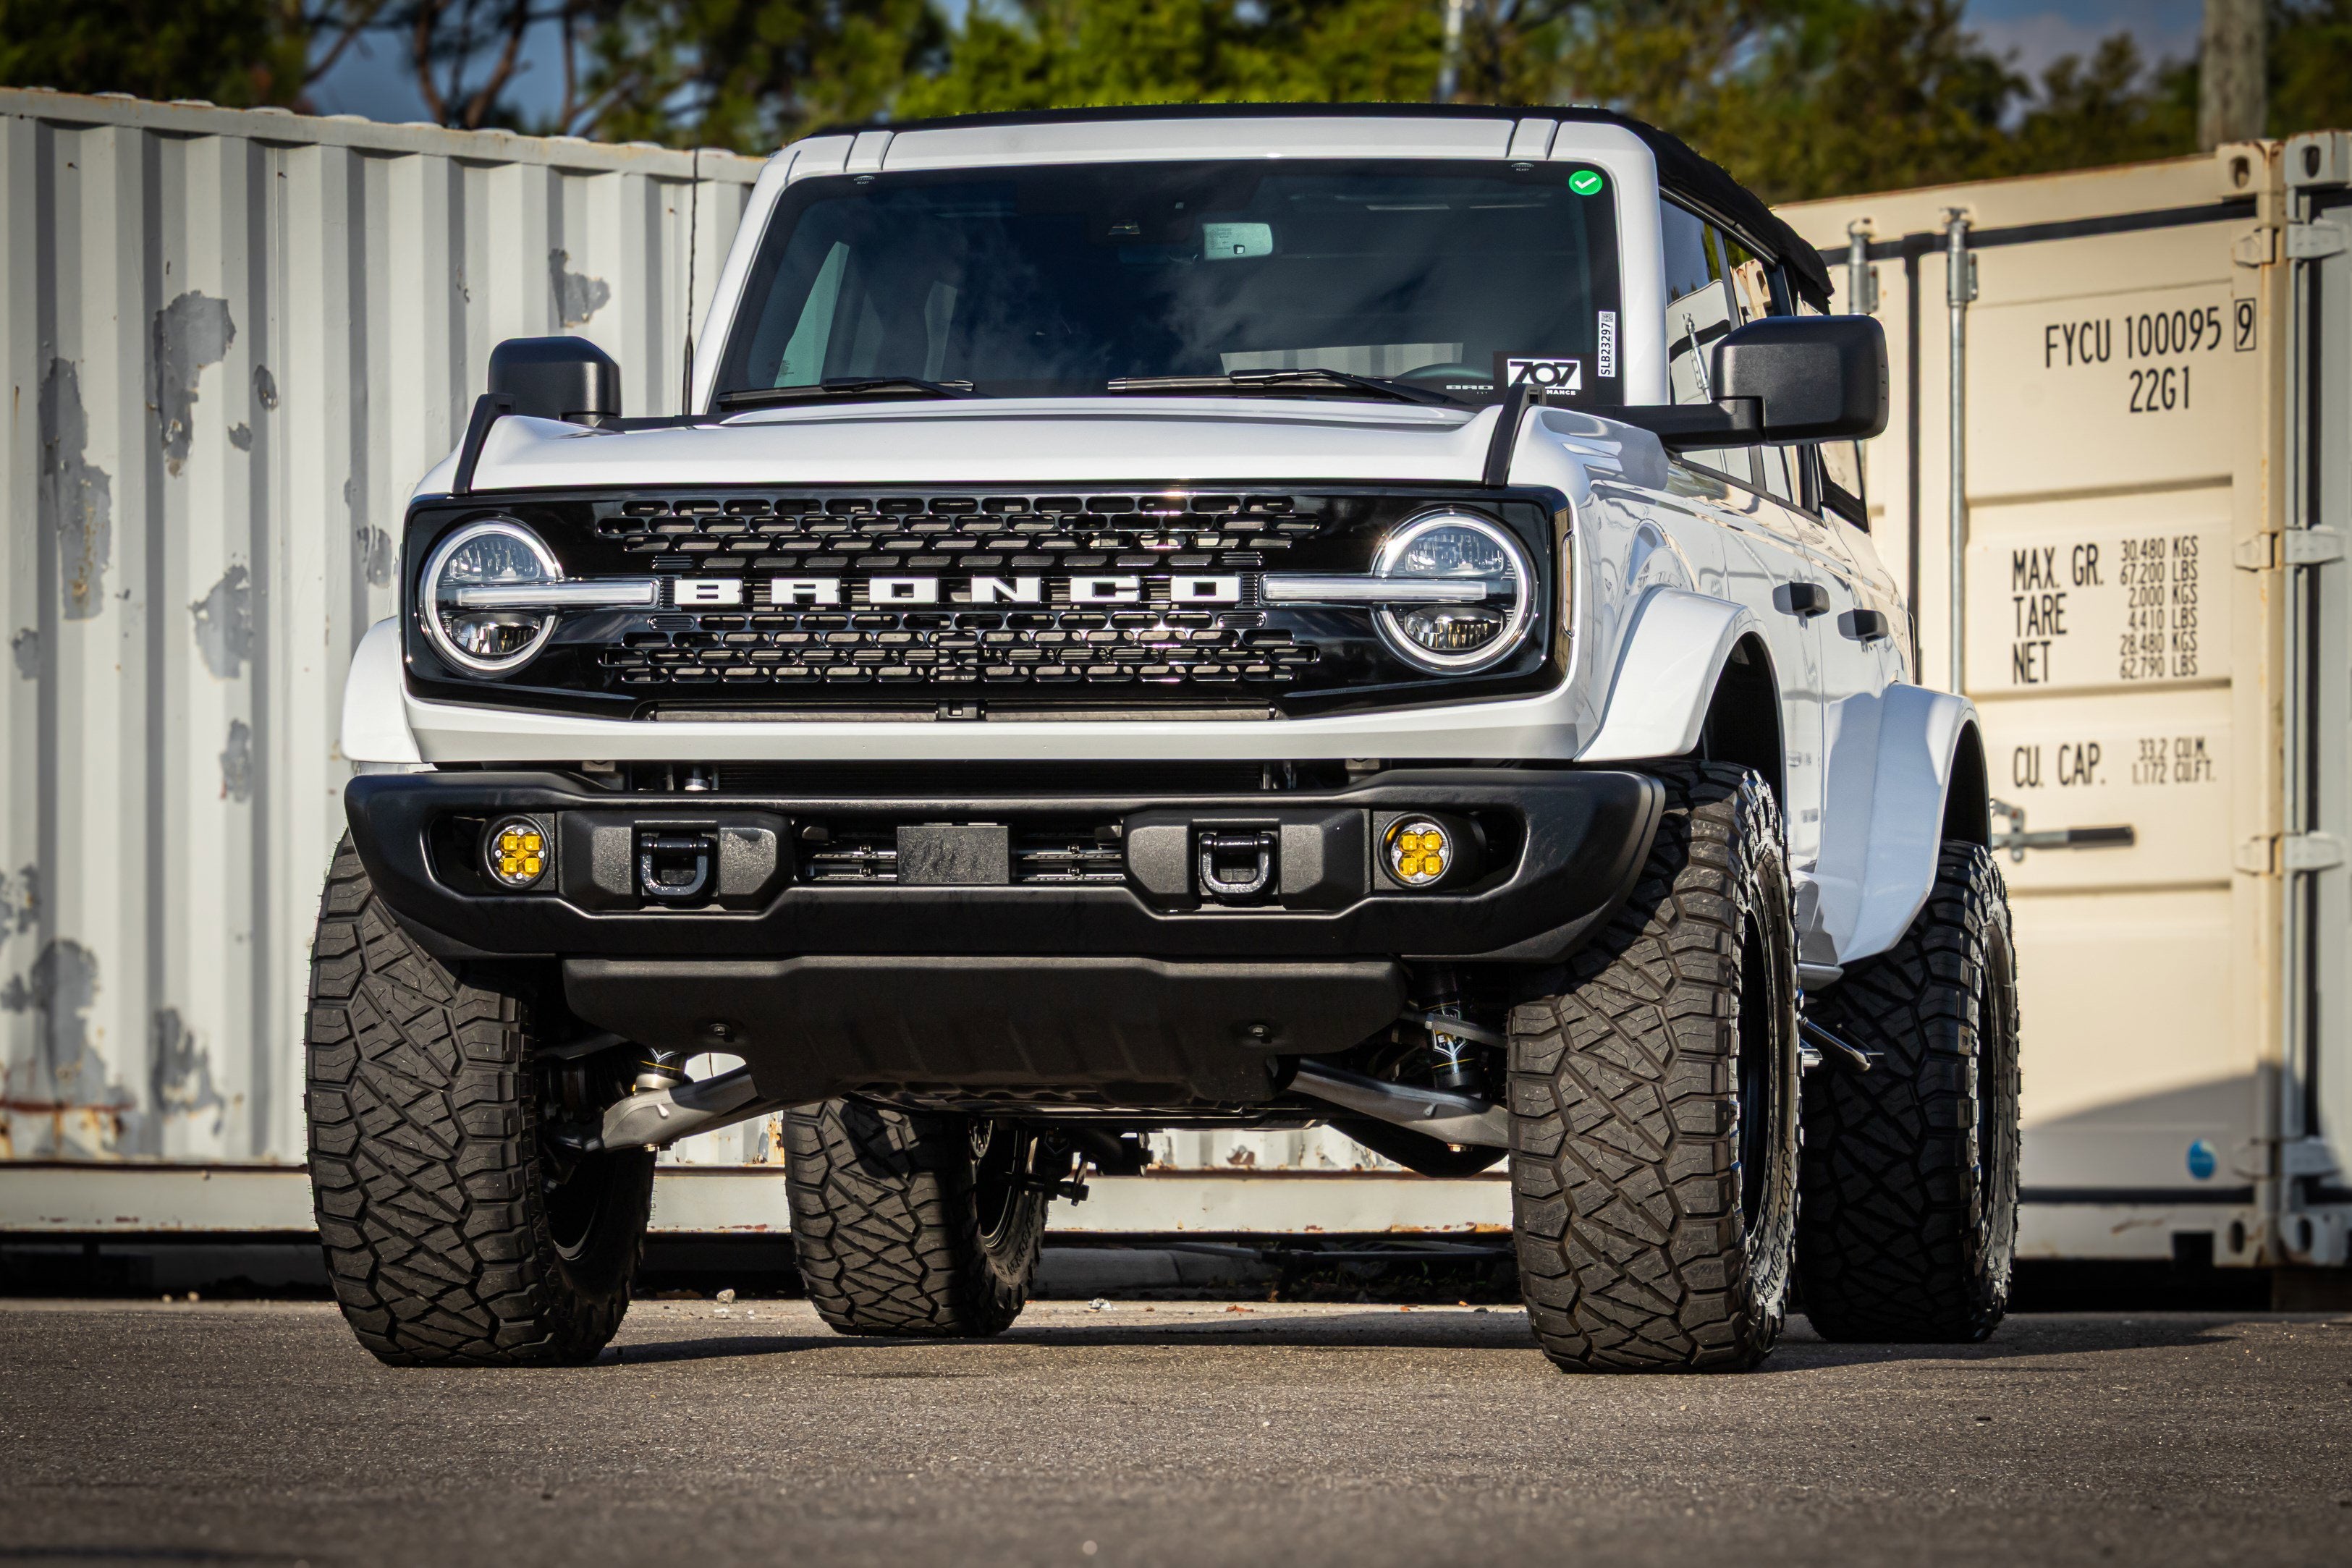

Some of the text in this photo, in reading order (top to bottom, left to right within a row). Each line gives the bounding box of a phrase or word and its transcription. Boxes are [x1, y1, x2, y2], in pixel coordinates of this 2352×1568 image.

[1601, 322, 1611, 375] SLB23297
[2046, 303, 2253, 368] FYCU 100095 9
[1510, 361, 1578, 388] 707
[2129, 366, 2190, 413] 22G1
[2120, 535, 2199, 561] 30.480 KGS
[2013, 543, 2104, 592] MAX. GR.
[2119, 559, 2199, 585] 67.200 LBS
[674, 576, 1242, 605] BRONCO
[2128, 582, 2198, 609] 2.000 KGS
[2013, 593, 2068, 637] TARE
[2128, 606, 2198, 632] 4.410 LBS
[2119, 630, 2198, 656] 28.480 KGS
[2013, 640, 2052, 685] NET
[2119, 653, 2198, 679] 62.790 LBS
[2013, 742, 2106, 788] CU. CAP.
